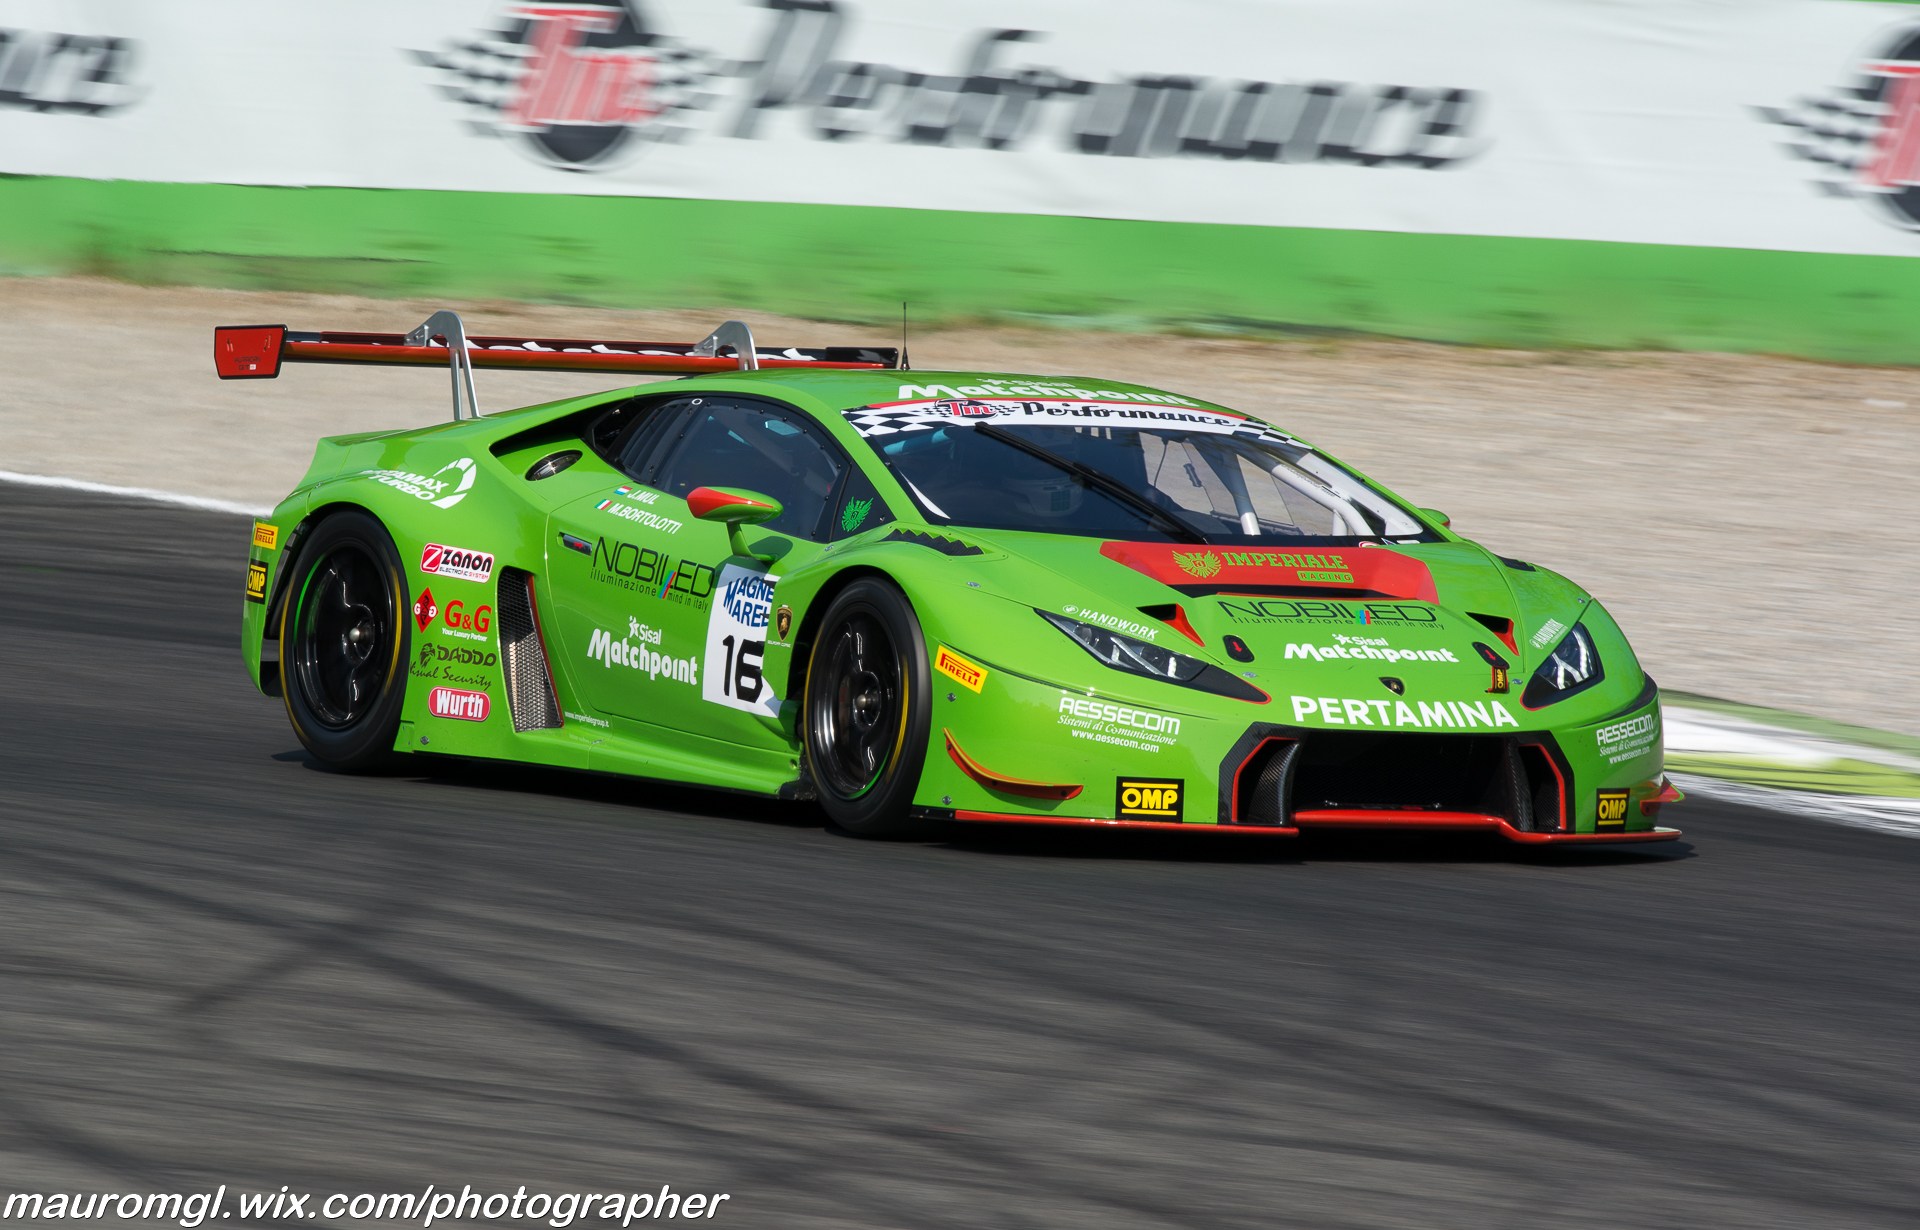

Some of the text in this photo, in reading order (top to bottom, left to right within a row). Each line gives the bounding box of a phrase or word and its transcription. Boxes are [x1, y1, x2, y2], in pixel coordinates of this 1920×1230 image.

[712, 0, 1487, 170] Performance
[899, 384, 1199, 407] Matchpoint
[1014, 401, 1236, 427] Performance
[368, 475, 435, 500] TURBO
[627, 490, 659, 505] J.MUL
[607, 503, 682, 534] M.BORTOLOTTI
[255, 528, 274, 544] PIRELLI
[593, 536, 715, 598] NOBILED
[1221, 553, 1348, 570] IMPERIALE
[248, 570, 265, 592] OMP
[468, 571, 488, 580] SYSTEM
[590, 568, 657, 597] illuminazione
[1300, 573, 1352, 581] RACING
[667, 592, 708, 613] mind in italy
[1217, 601, 1436, 622] NOBILED
[444, 600, 492, 633] G&G
[1079, 608, 1159, 639] HANDWORK
[1232, 617, 1353, 625] illuminazione
[1373, 619, 1400, 627] mind
[1420, 621, 1445, 630] italy
[442, 628, 488, 642] Your Luxury Partner
[638, 624, 661, 645] Sisal
[1351, 636, 1389, 647] Sisal
[437, 645, 497, 667] DADDO
[587, 628, 697, 685] Matchpoint
[1284, 643, 1459, 663] Matchpoint
[442, 666, 491, 692] Security
[722, 635, 763, 703] 16
[940, 653, 980, 686] PIRELLI
[437, 690, 484, 718] Wurth
[1290, 695, 1519, 727] PERTAMINA
[1059, 697, 1180, 735] AESSECOM
[1057, 715, 1177, 745] Sistemi di Comunicazione
[1072, 729, 1159, 753] www.aessecom.com
[1596, 714, 1653, 745] AESSECOM
[1122, 788, 1178, 809] OMP
[1599, 799, 1626, 819] OMP
